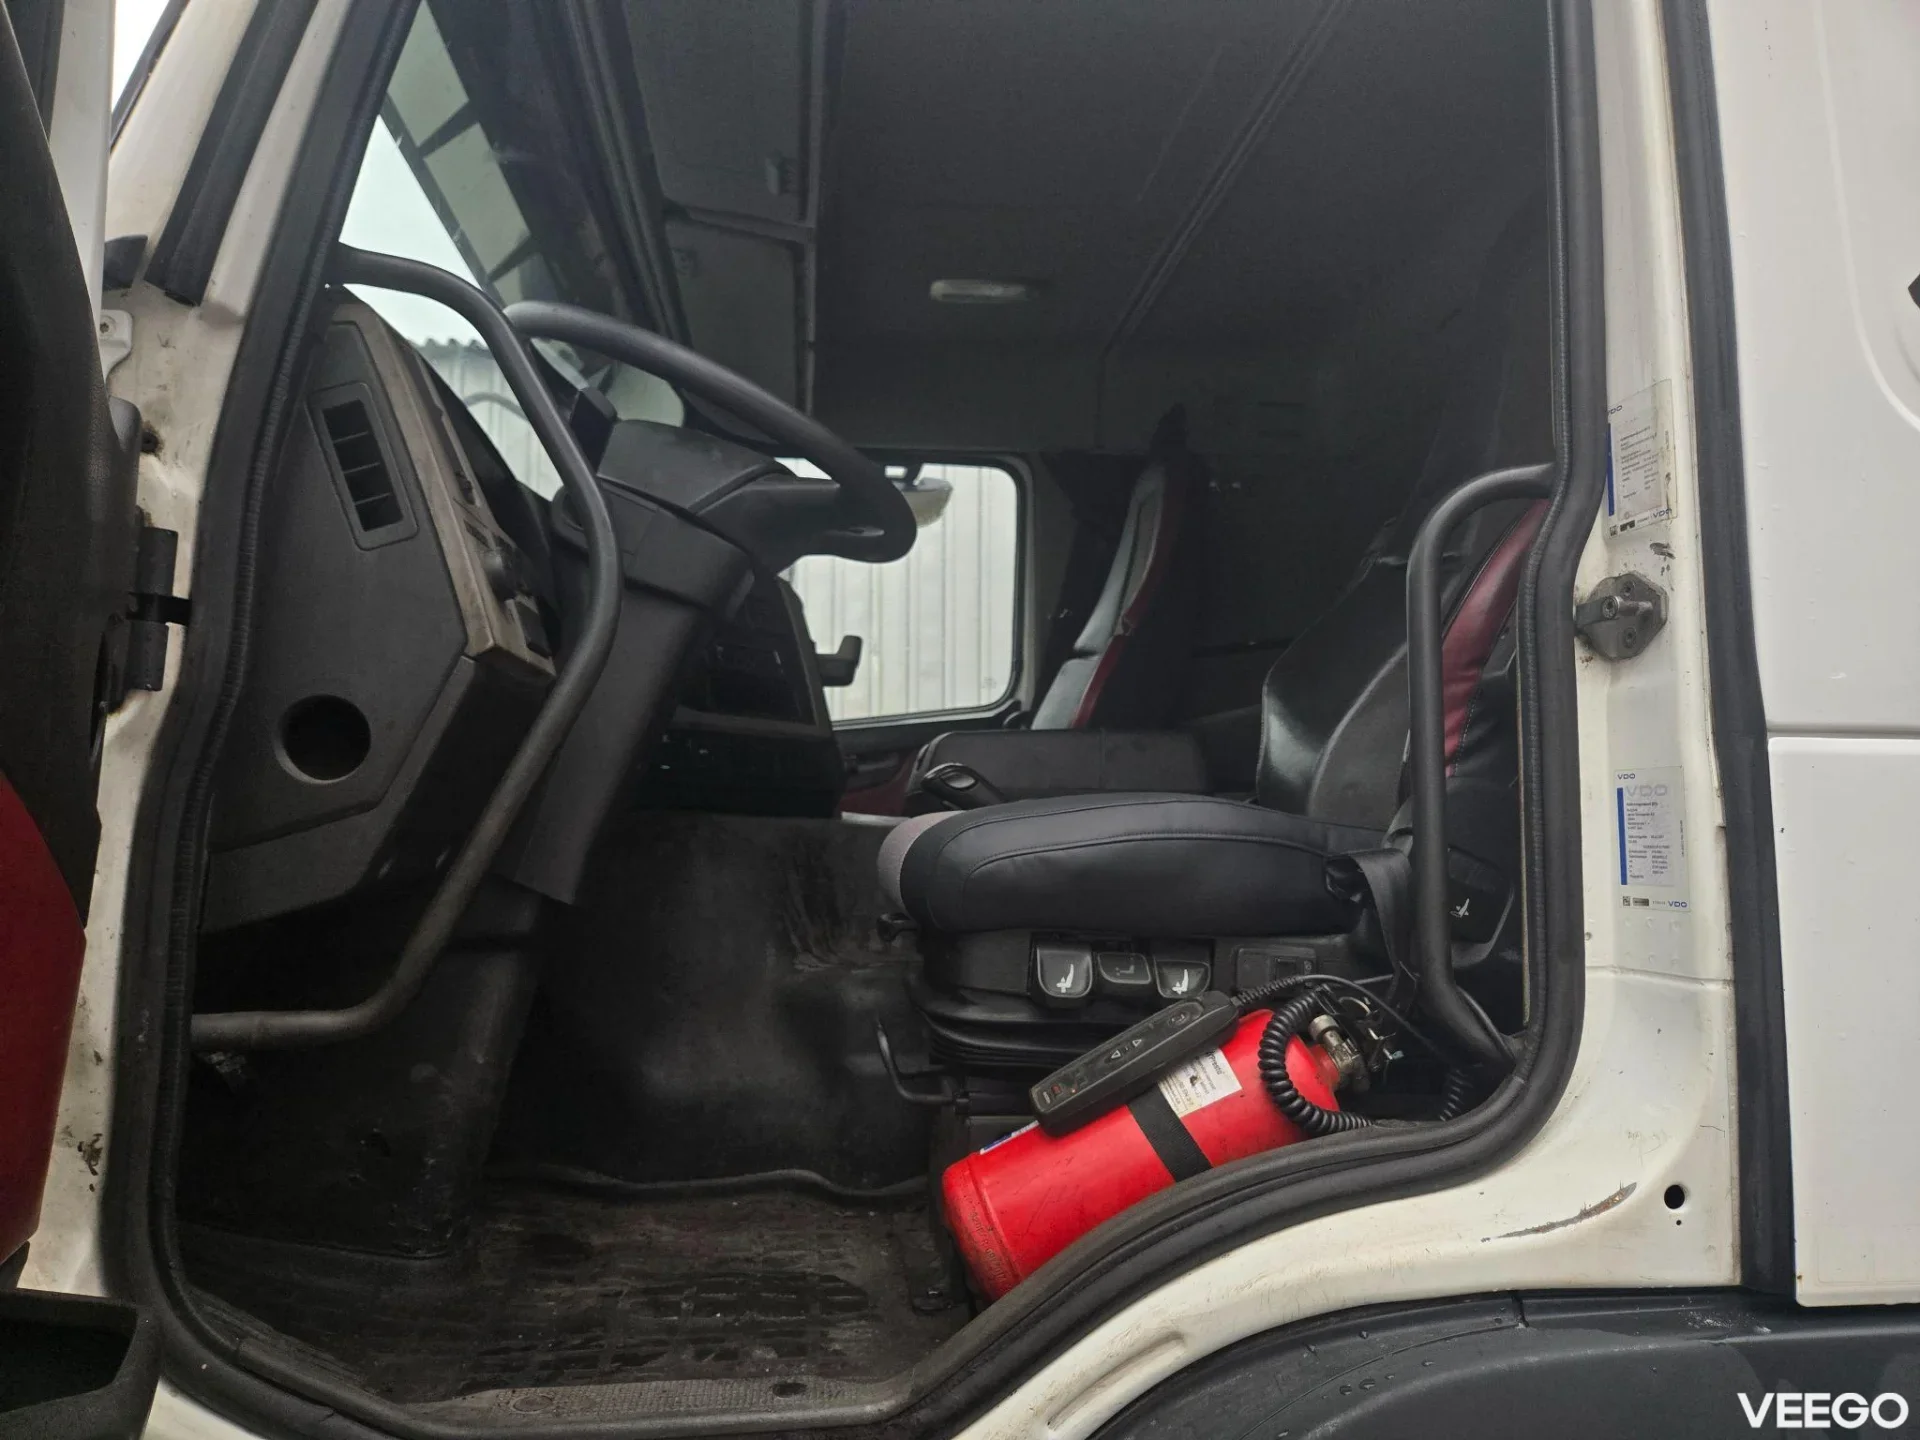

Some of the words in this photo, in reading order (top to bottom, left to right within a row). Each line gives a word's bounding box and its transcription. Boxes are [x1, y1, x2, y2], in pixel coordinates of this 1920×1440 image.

[1652, 508, 1672, 518] VDO
[1626, 784, 1669, 798] VDO
[1667, 900, 1688, 908] VDO
